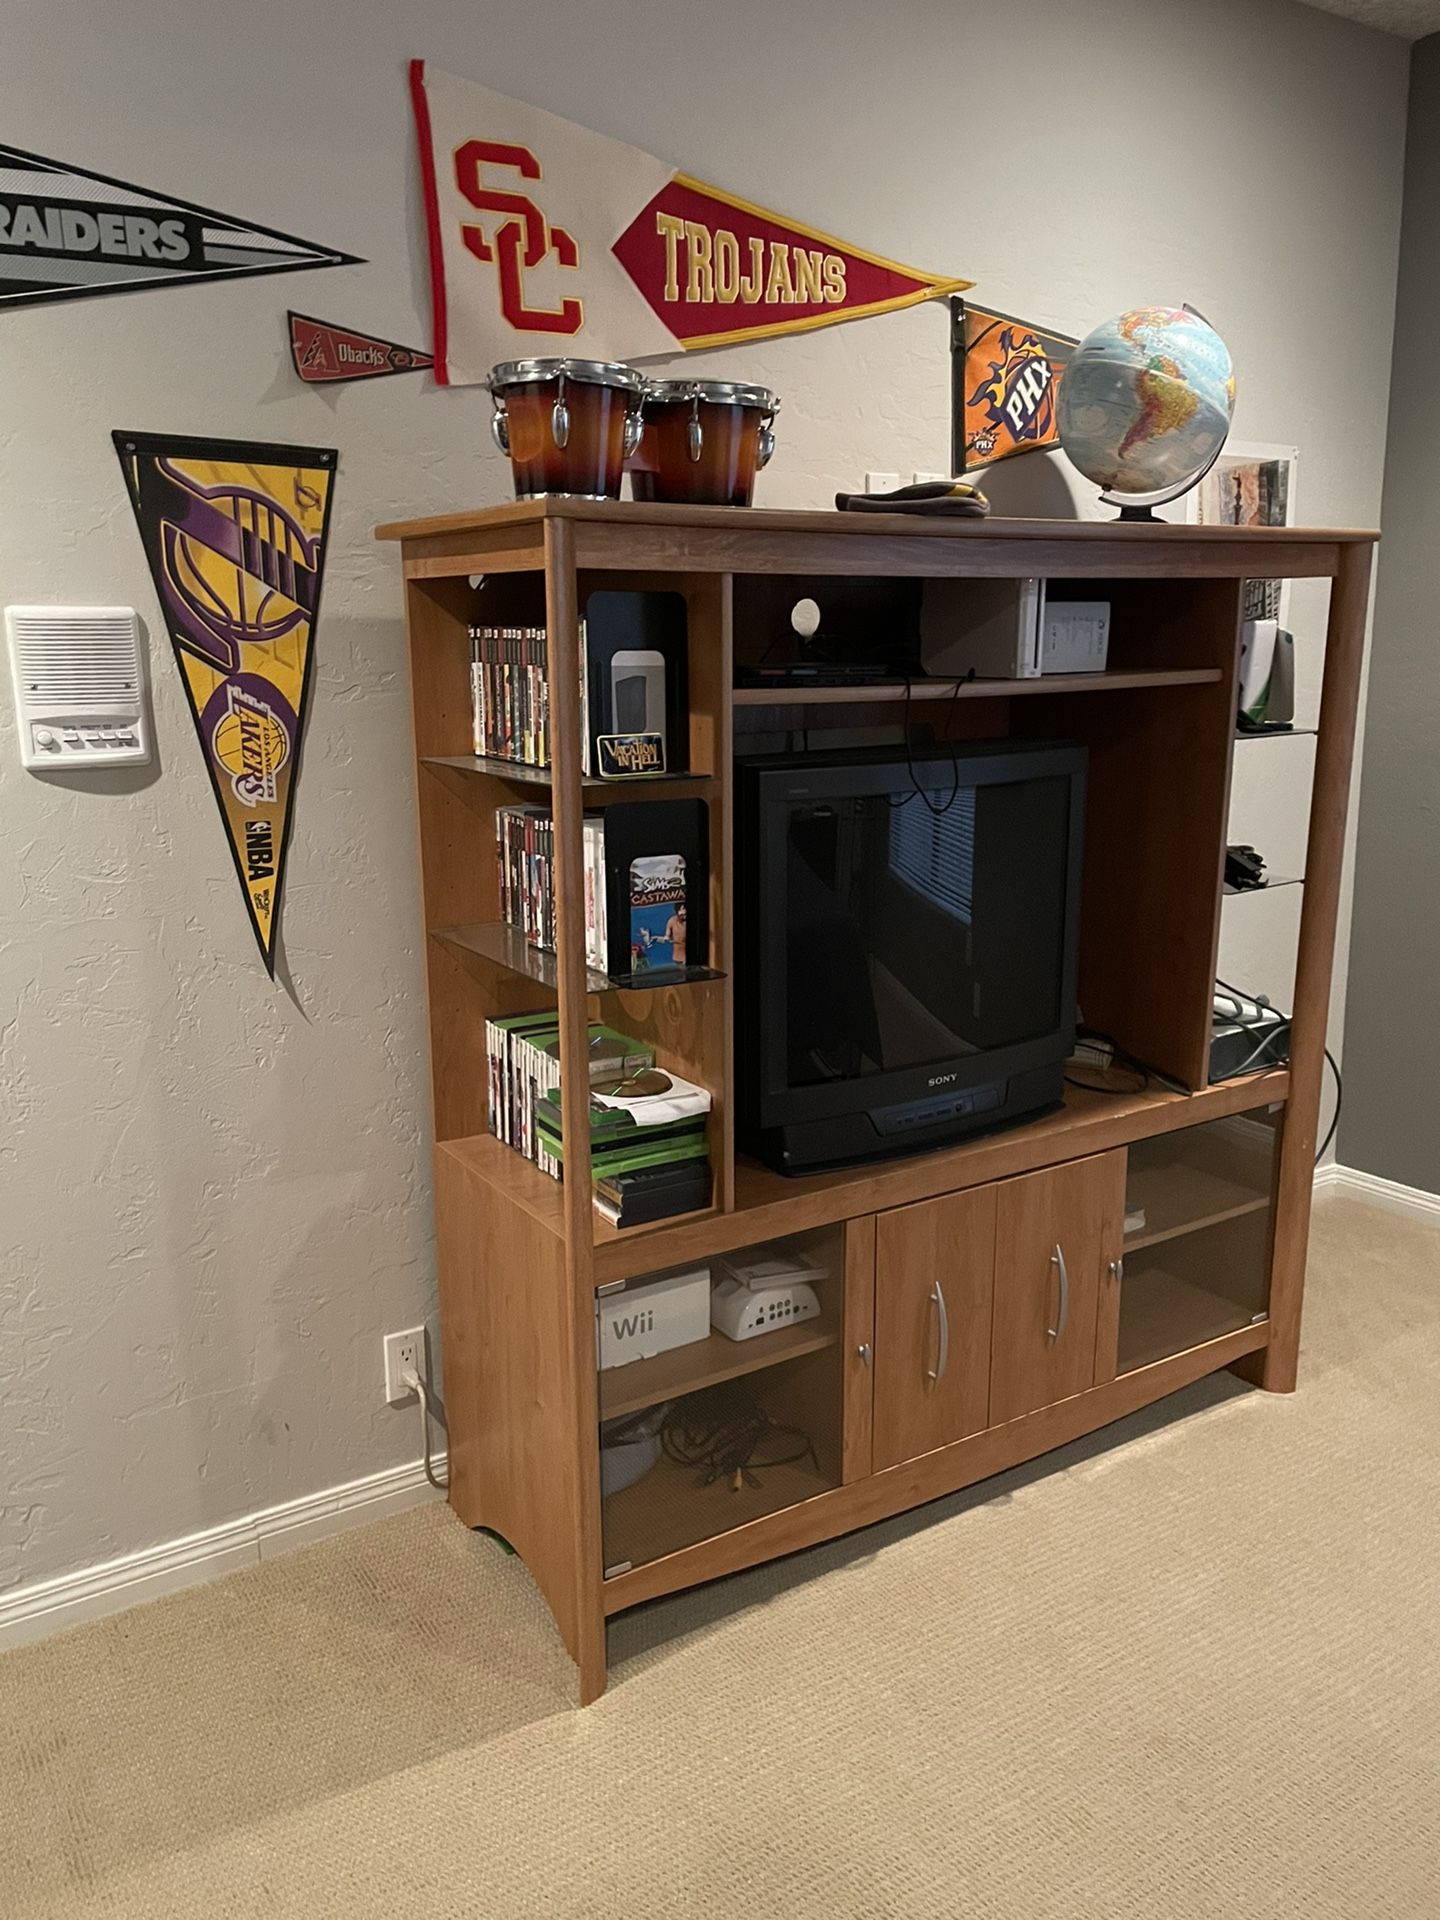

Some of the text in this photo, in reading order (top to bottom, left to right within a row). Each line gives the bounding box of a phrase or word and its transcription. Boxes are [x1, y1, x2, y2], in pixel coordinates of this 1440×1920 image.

[657, 211, 846, 303] TROJANS
[338, 343, 385, 367] Dbacks
[1005, 359, 1052, 432] PHX
[975, 440, 993, 449] PHX
[230, 690, 270, 804] LAKERS
[603, 738, 657, 758] VACATION
[618, 753, 660, 770] IN HELL
[263, 727, 274, 798] LOS ANGELES
[246, 832, 274, 881] NBA
[928, 1073, 958, 1087] SONY
[612, 1310, 653, 1340] Wii
